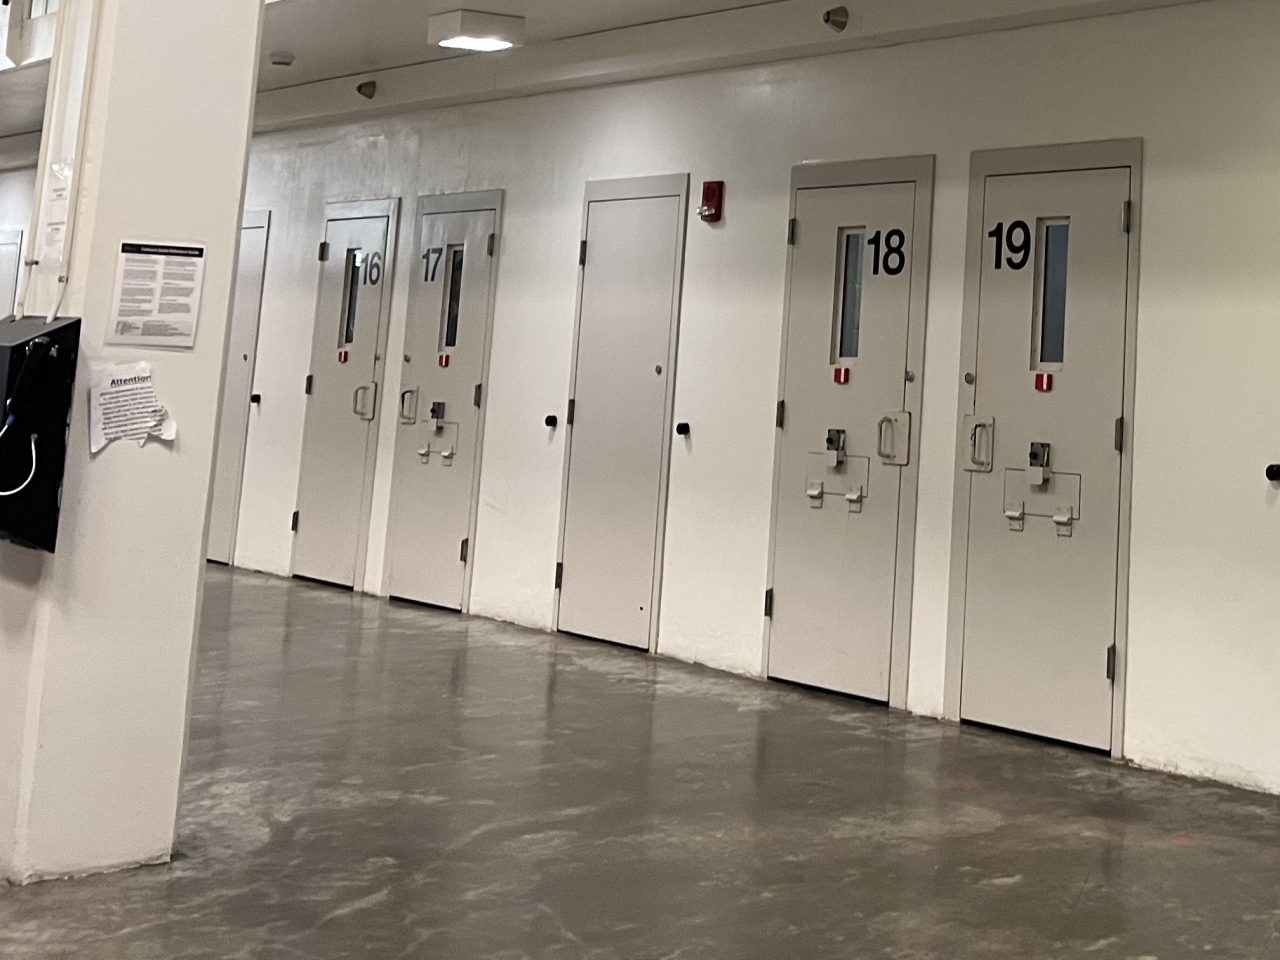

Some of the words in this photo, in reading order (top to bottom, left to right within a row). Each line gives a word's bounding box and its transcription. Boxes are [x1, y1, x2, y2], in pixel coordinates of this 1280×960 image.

[868, 229, 905, 275] 18
[988, 220, 1031, 270] 19
[361, 251, 381, 285] 16
[422, 247, 443, 282] 17
[110, 375, 152, 387] Attention
